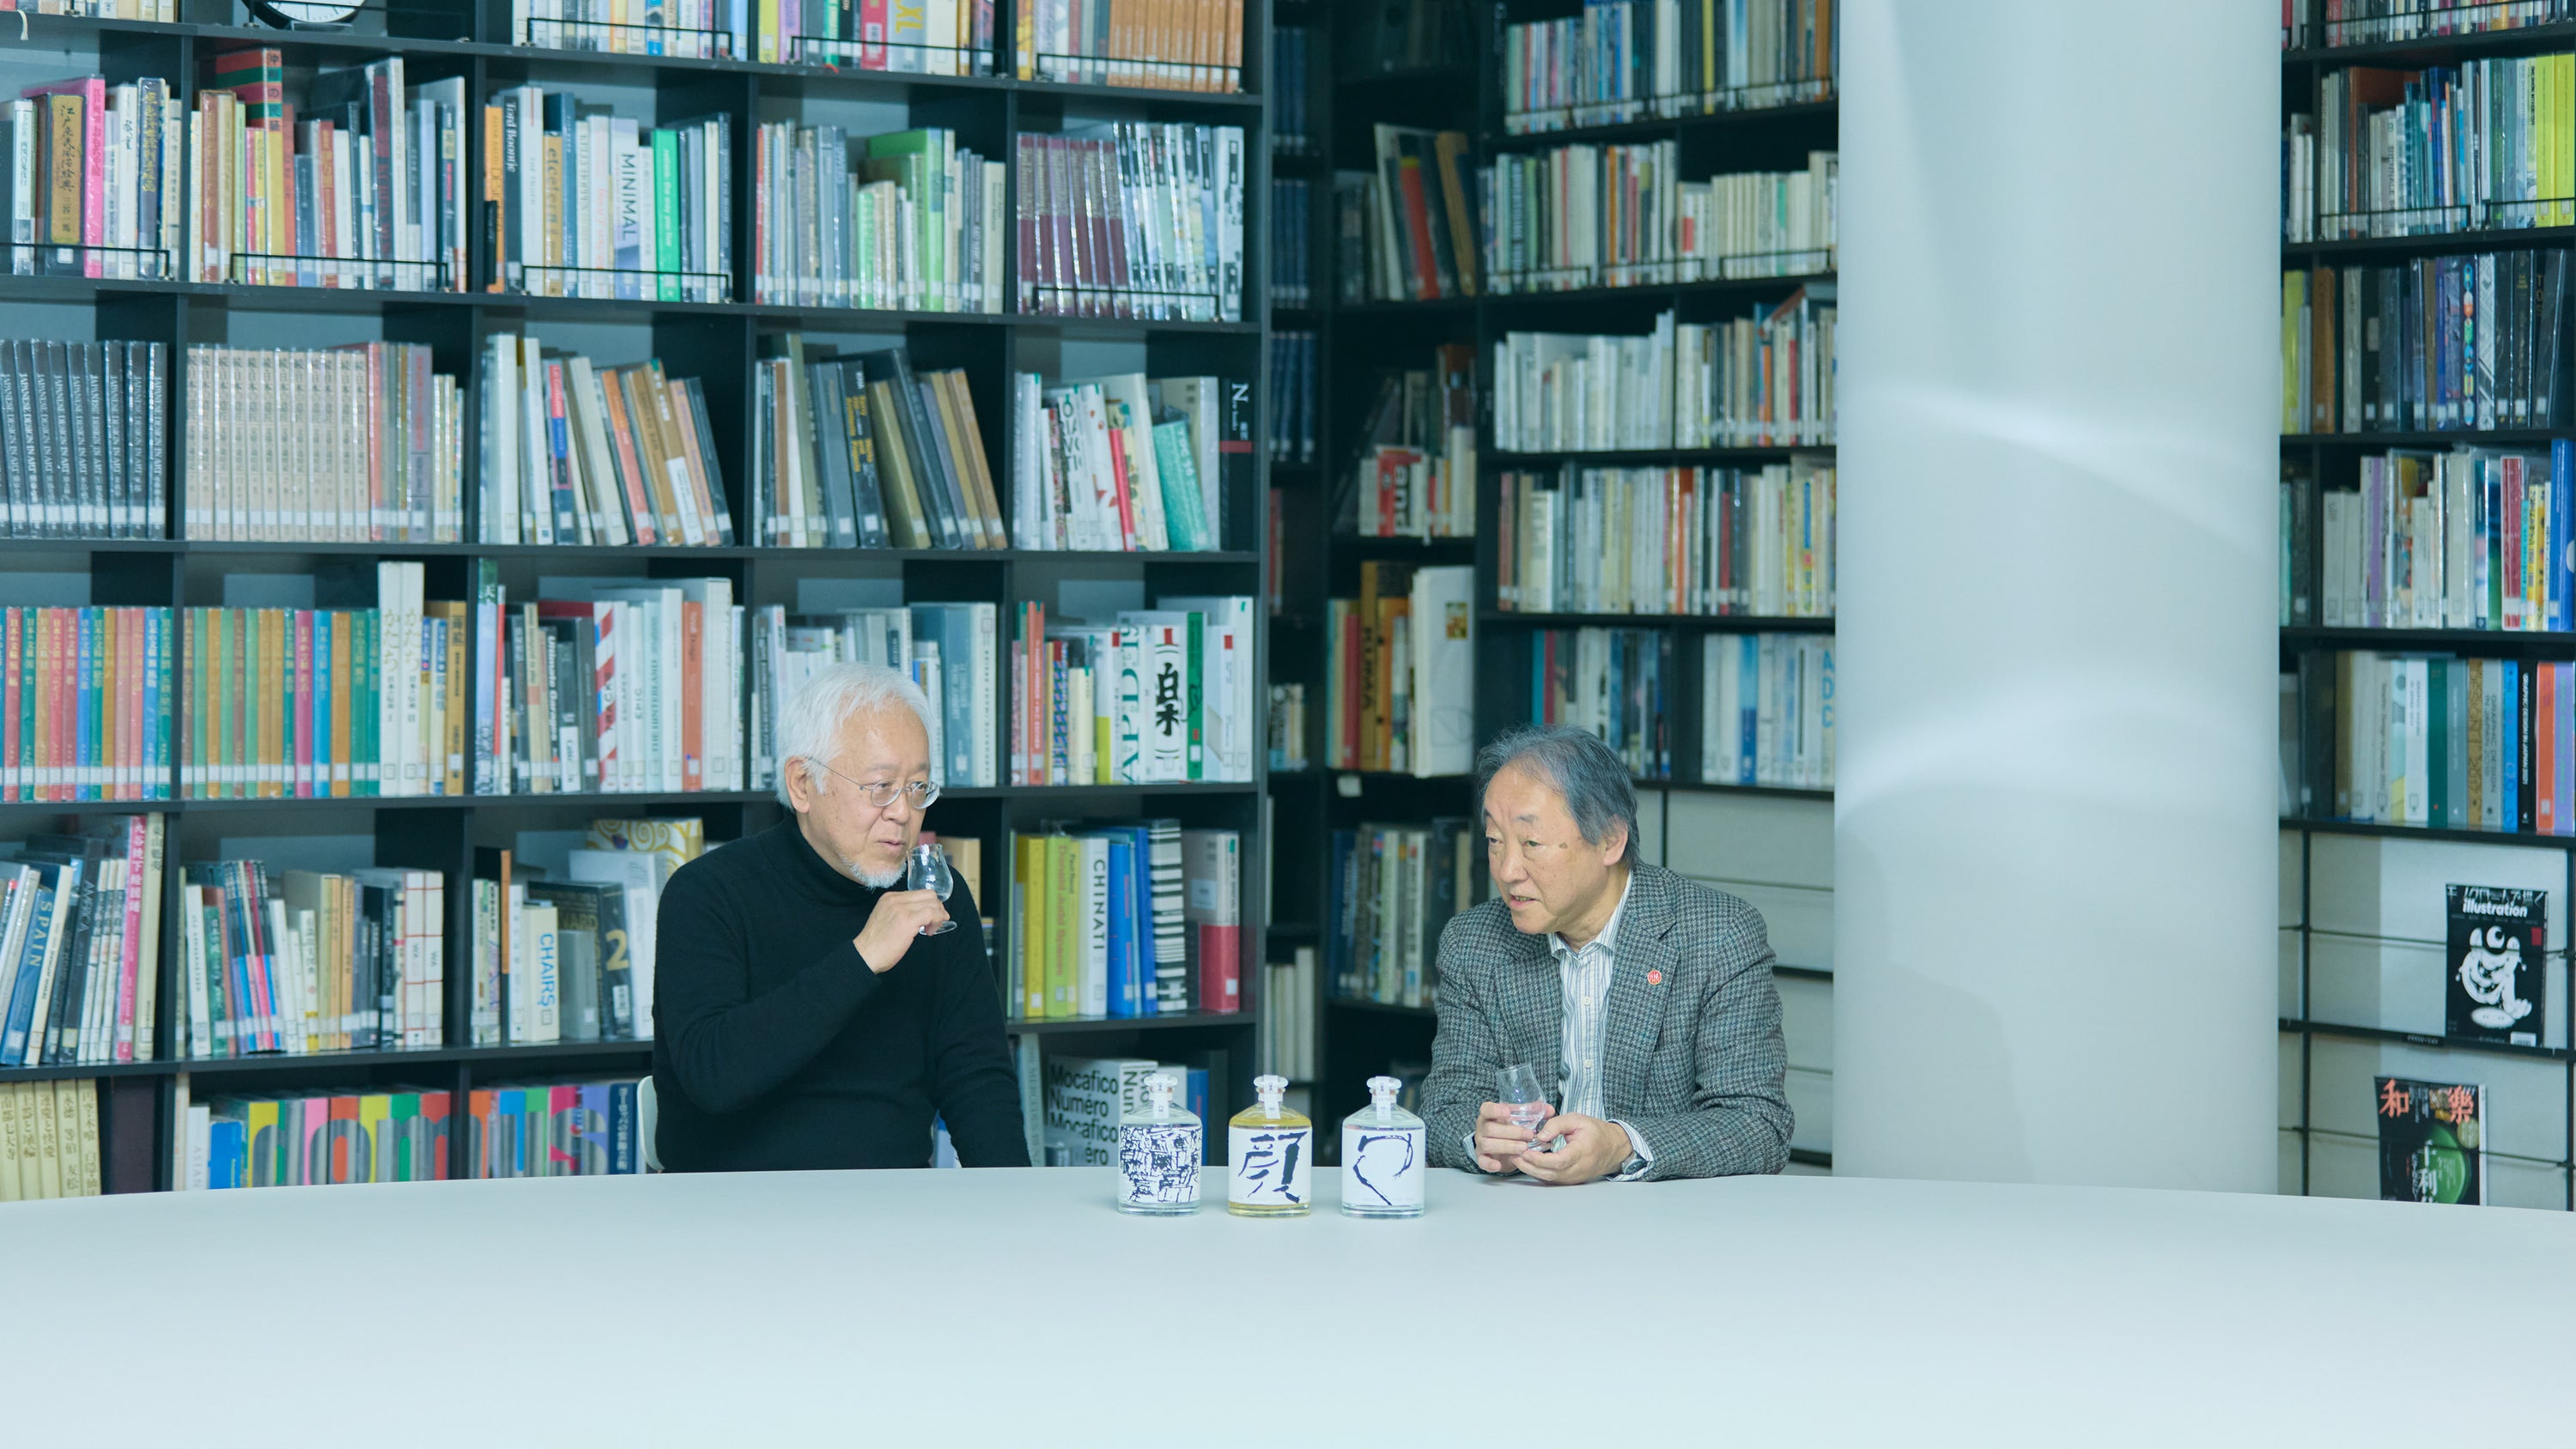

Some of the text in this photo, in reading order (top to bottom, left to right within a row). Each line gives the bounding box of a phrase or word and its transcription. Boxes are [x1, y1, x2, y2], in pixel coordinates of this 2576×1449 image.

[505, 102, 517, 172] Tord Boontje
[621, 153, 637, 241] MINIMAL
[664, 180, 672, 196] the
[664, 197, 672, 214] way
[2, 373, 13, 413] JAPANESE
[20, 373, 30, 412] JAPANESE
[37, 374, 47, 412] JAPANESE
[54, 375, 64, 414] JAPANESE
[72, 376, 82, 414] JAPANESE
[89, 374, 99, 414] JAPANESE
[109, 376, 118, 413] JAPANESE
[7, 414, 15, 445] DESIGN
[23, 414, 33, 444] DESIGN
[40, 414, 50, 445] DESIGN
[58, 415, 66, 445] DESIGN
[76, 415, 85, 445] DESIGN
[92, 415, 100, 445] DESIGN
[112, 415, 120, 446] DESIGN
[10, 455, 19, 474] ART
[61, 455, 70, 474] ART
[852, 440, 861, 472] Projects
[384, 608, 401, 672] かたち
[405, 608, 421, 672] かたち
[548, 634, 558, 742] Ultimate Garages
[1057, 893, 1066, 926] Judd
[1093, 858, 1106, 950] CHINATI
[2462, 897, 2528, 918] illustration
[30, 900, 53, 967] SPAIN
[605, 929, 629, 972] 2
[538, 933, 556, 1007] CHAIRS
[1049, 1063, 1119, 1095] Mocafico
[1049, 1088, 1109, 1118] Numéro
[2379, 1078, 2410, 1119] 和
[2416, 1139, 2439, 1203] 千利
